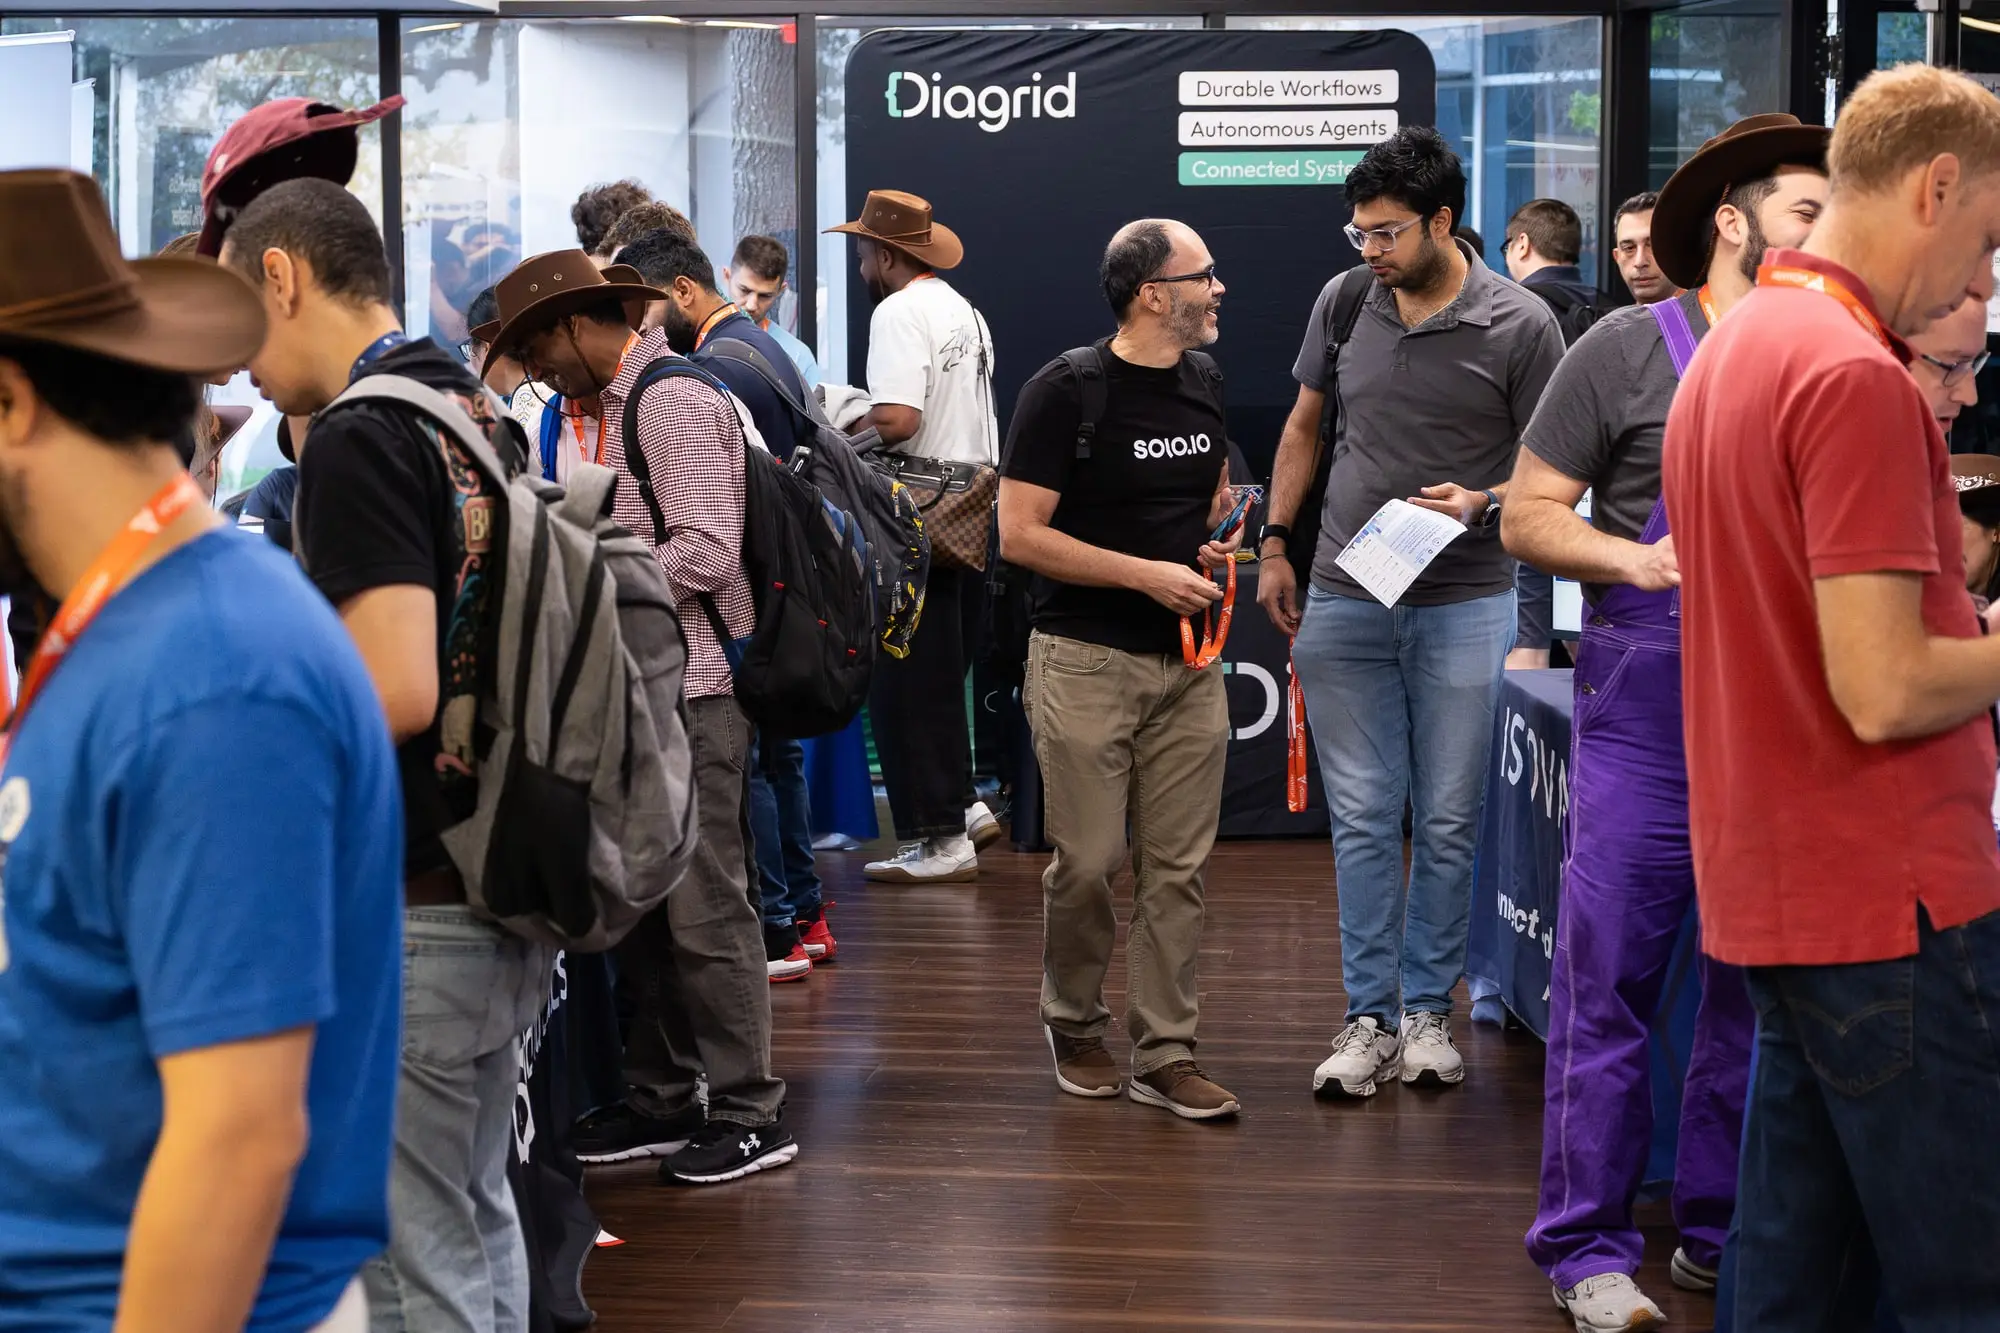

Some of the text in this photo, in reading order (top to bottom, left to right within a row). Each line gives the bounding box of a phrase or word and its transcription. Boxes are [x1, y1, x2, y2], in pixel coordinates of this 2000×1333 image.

[1197, 79, 1382, 98] Durable Workflows
[884, 71, 1077, 133] Diagrid
[1190, 119, 1388, 143] Autonomous Agents
[1191, 159, 1354, 182] Connected Syste
